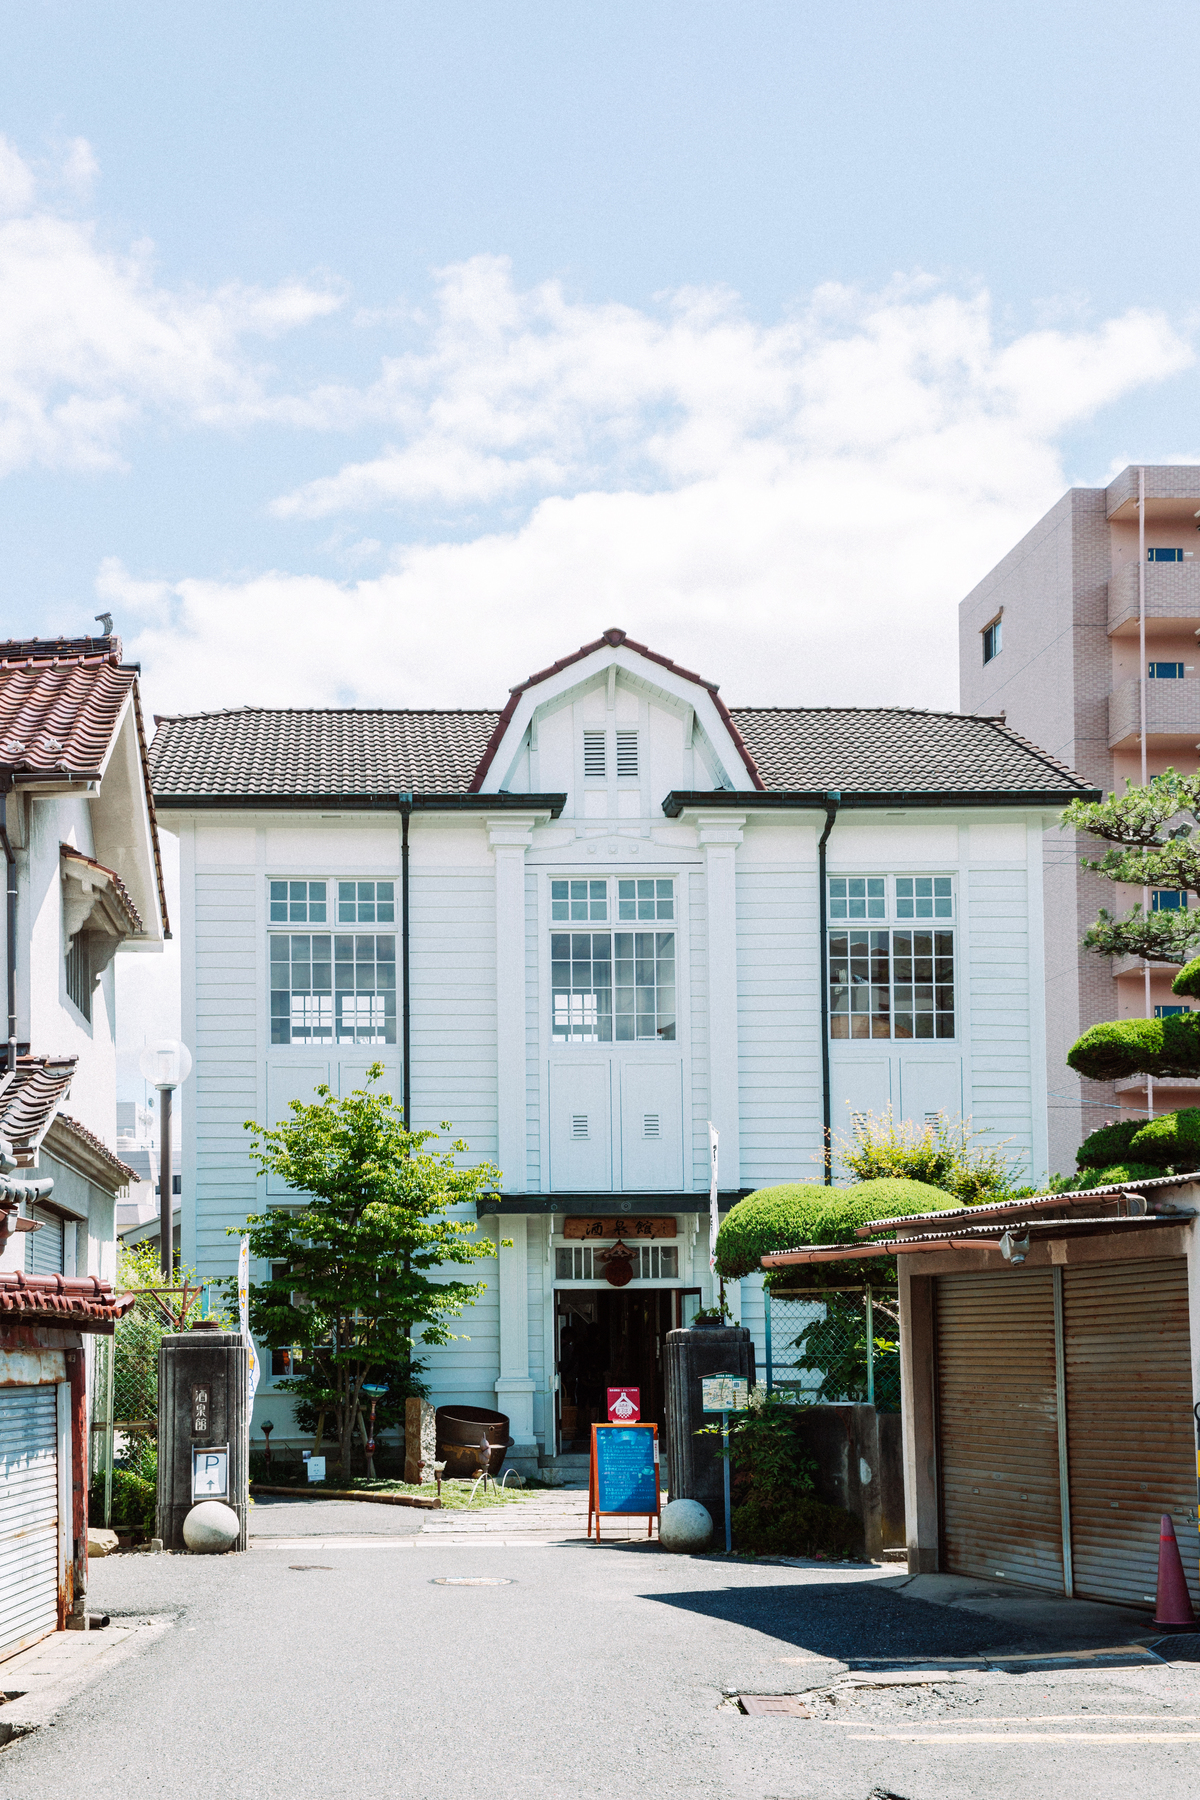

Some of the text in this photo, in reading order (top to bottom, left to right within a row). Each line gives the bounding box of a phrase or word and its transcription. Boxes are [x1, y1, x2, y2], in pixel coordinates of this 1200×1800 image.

[585, 1220, 654, 1236] 酒泉館
[195, 1389, 208, 1431] 酒泉館
[205, 1455, 219, 1474] P
